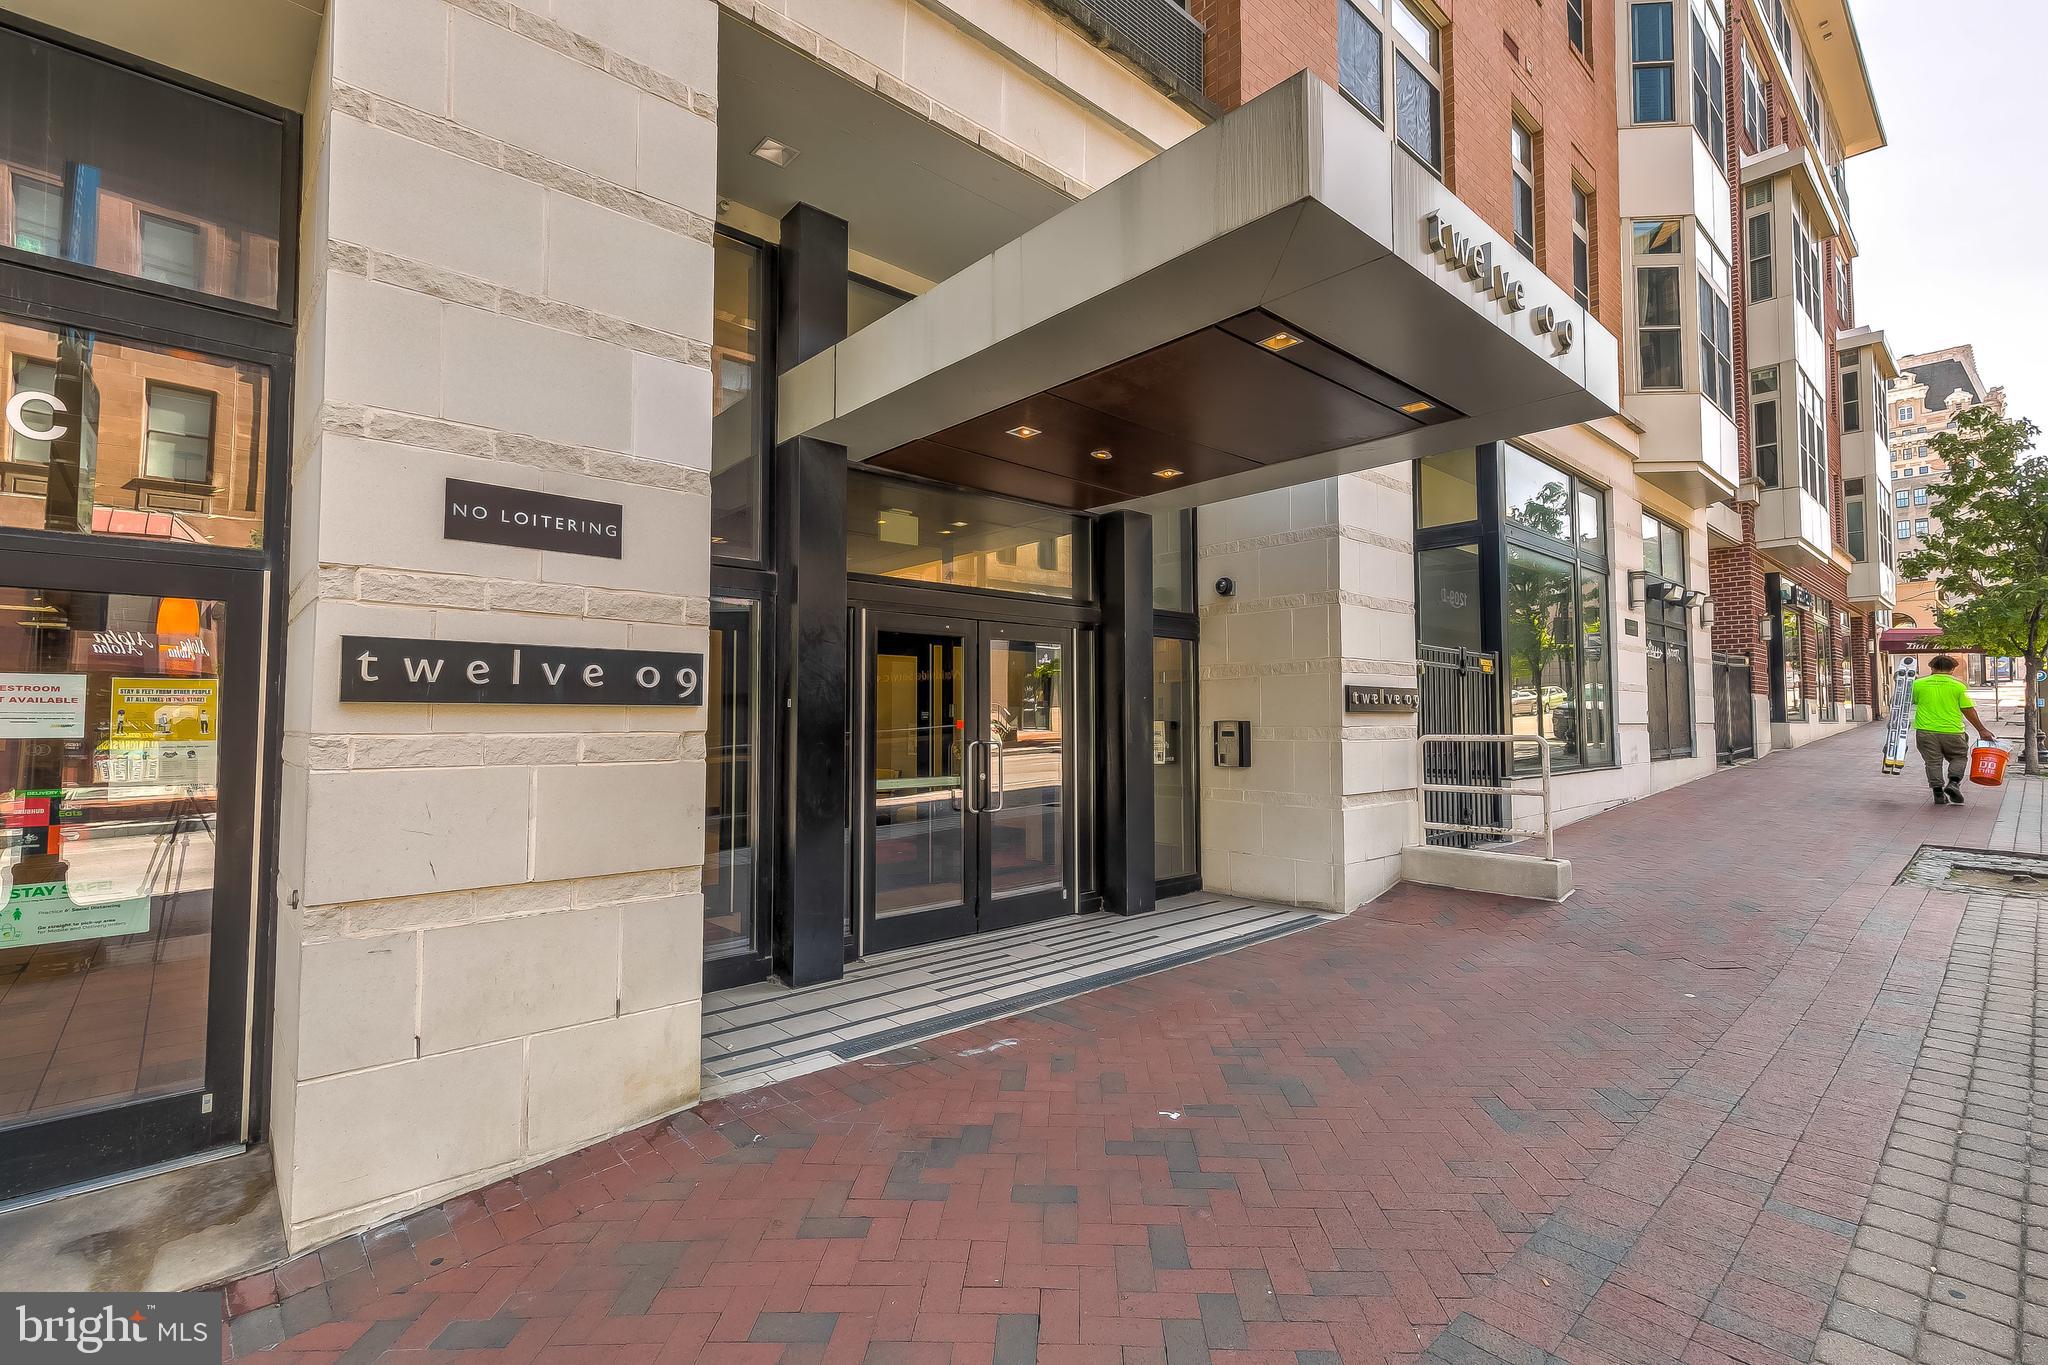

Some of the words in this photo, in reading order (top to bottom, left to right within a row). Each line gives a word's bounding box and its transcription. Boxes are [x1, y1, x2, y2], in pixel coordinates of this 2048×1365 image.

[1425, 208, 1525, 314] twelve
[453, 502, 488, 520] NO
[501, 509, 617, 537] LOITERING
[356, 649, 604, 686] twelve
[1352, 688, 1400, 705] twelve
[10, 885, 56, 899] STAY
